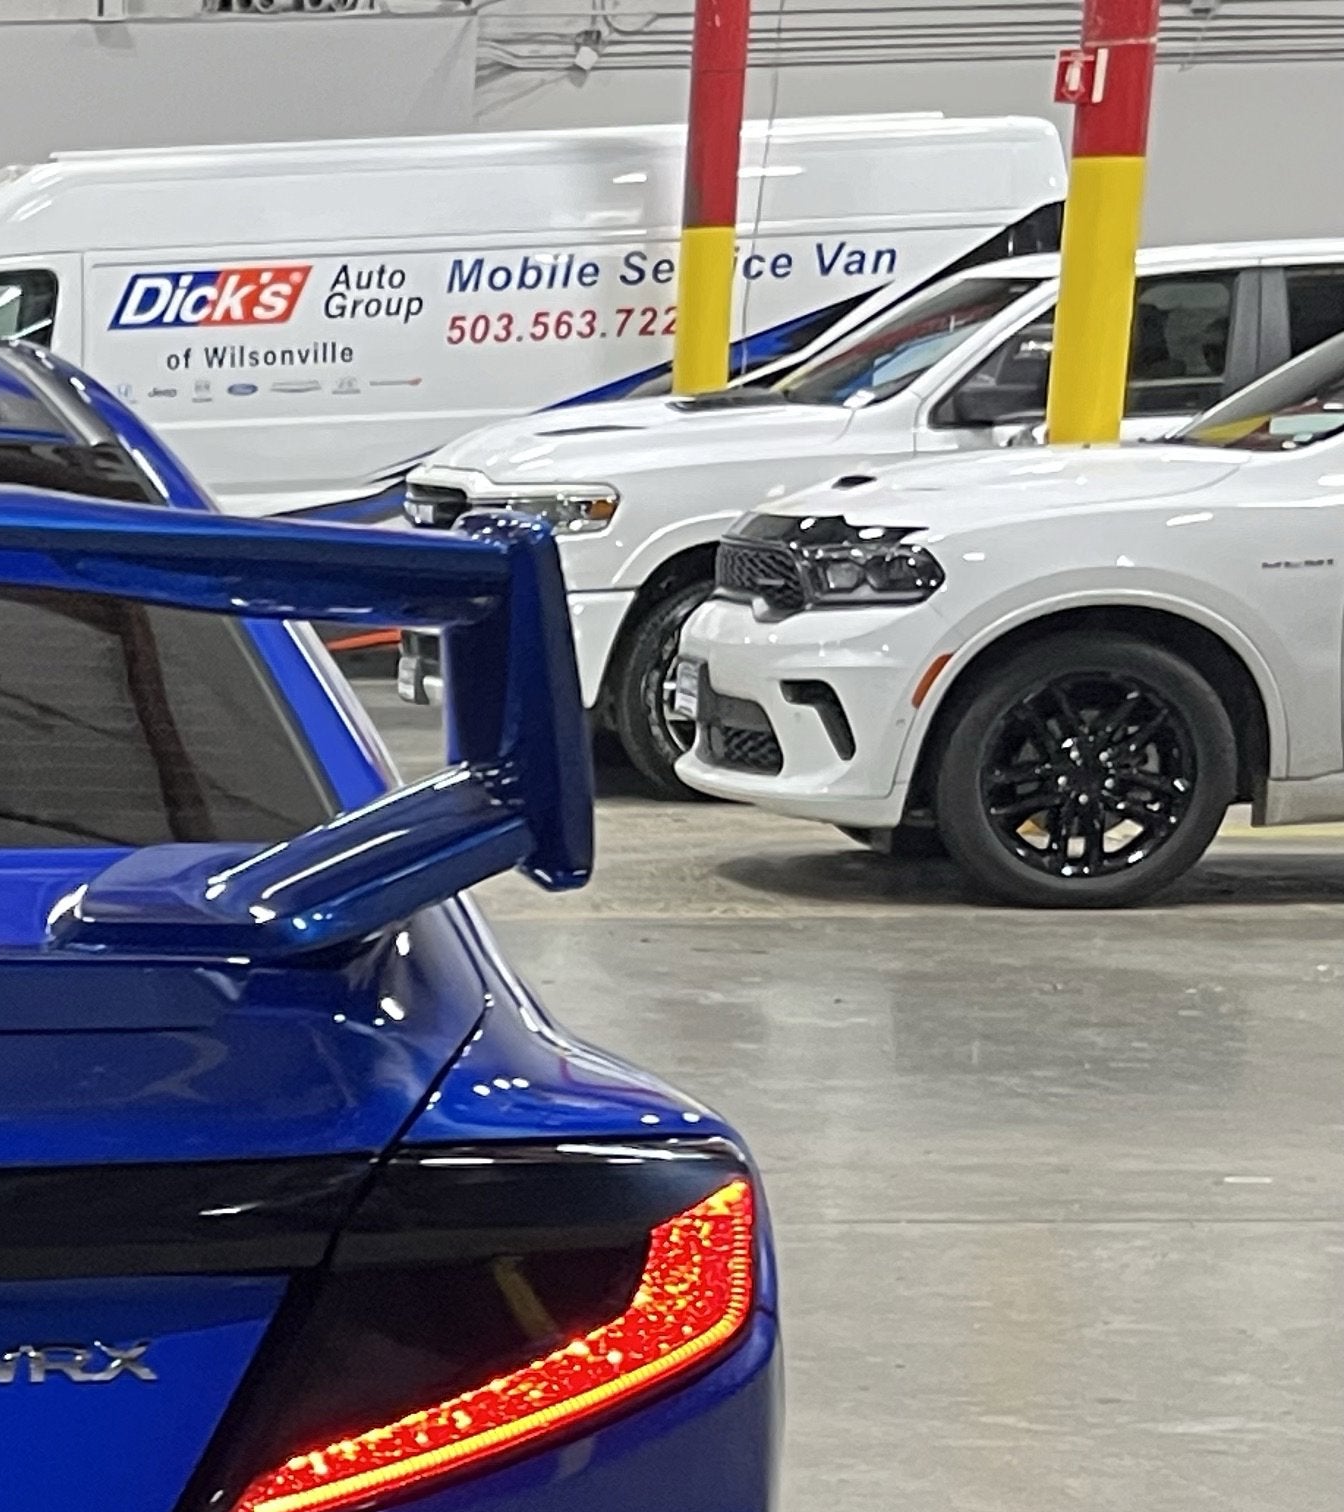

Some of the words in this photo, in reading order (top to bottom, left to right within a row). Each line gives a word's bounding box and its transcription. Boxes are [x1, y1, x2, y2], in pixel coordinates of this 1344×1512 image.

[330, 264, 406, 292] Auto
[446, 254, 600, 294] Mobile
[815, 241, 897, 277] Van
[324, 292, 424, 324] Group
[167, 348, 192, 370] of
[204, 341, 354, 369] Wilsonville
